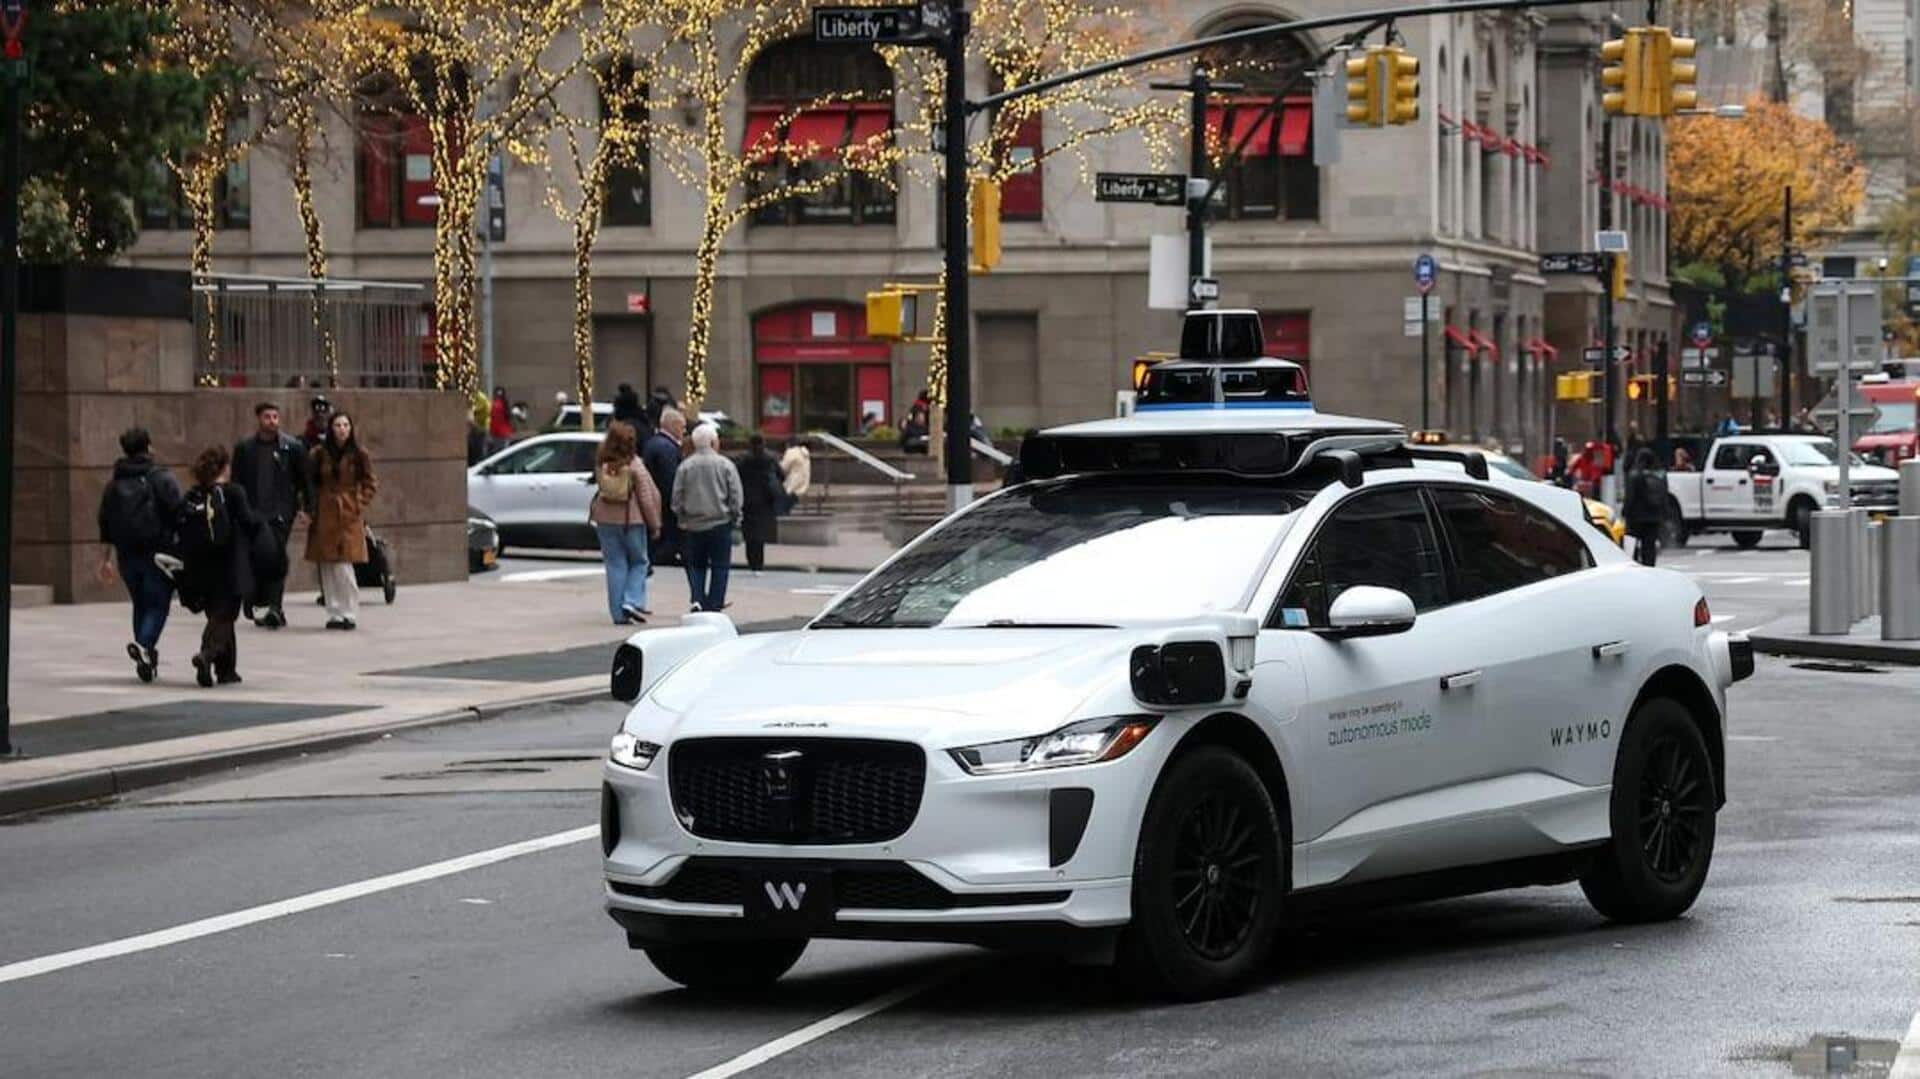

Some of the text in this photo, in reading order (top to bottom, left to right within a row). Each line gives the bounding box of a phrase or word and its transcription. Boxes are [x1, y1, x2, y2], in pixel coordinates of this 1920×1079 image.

[821, 17, 881, 38] Liberty
[1103, 181, 1146, 199] Liberty
[1328, 708, 1432, 746] autonomous mode
[1550, 719, 1611, 747] WAYMO
